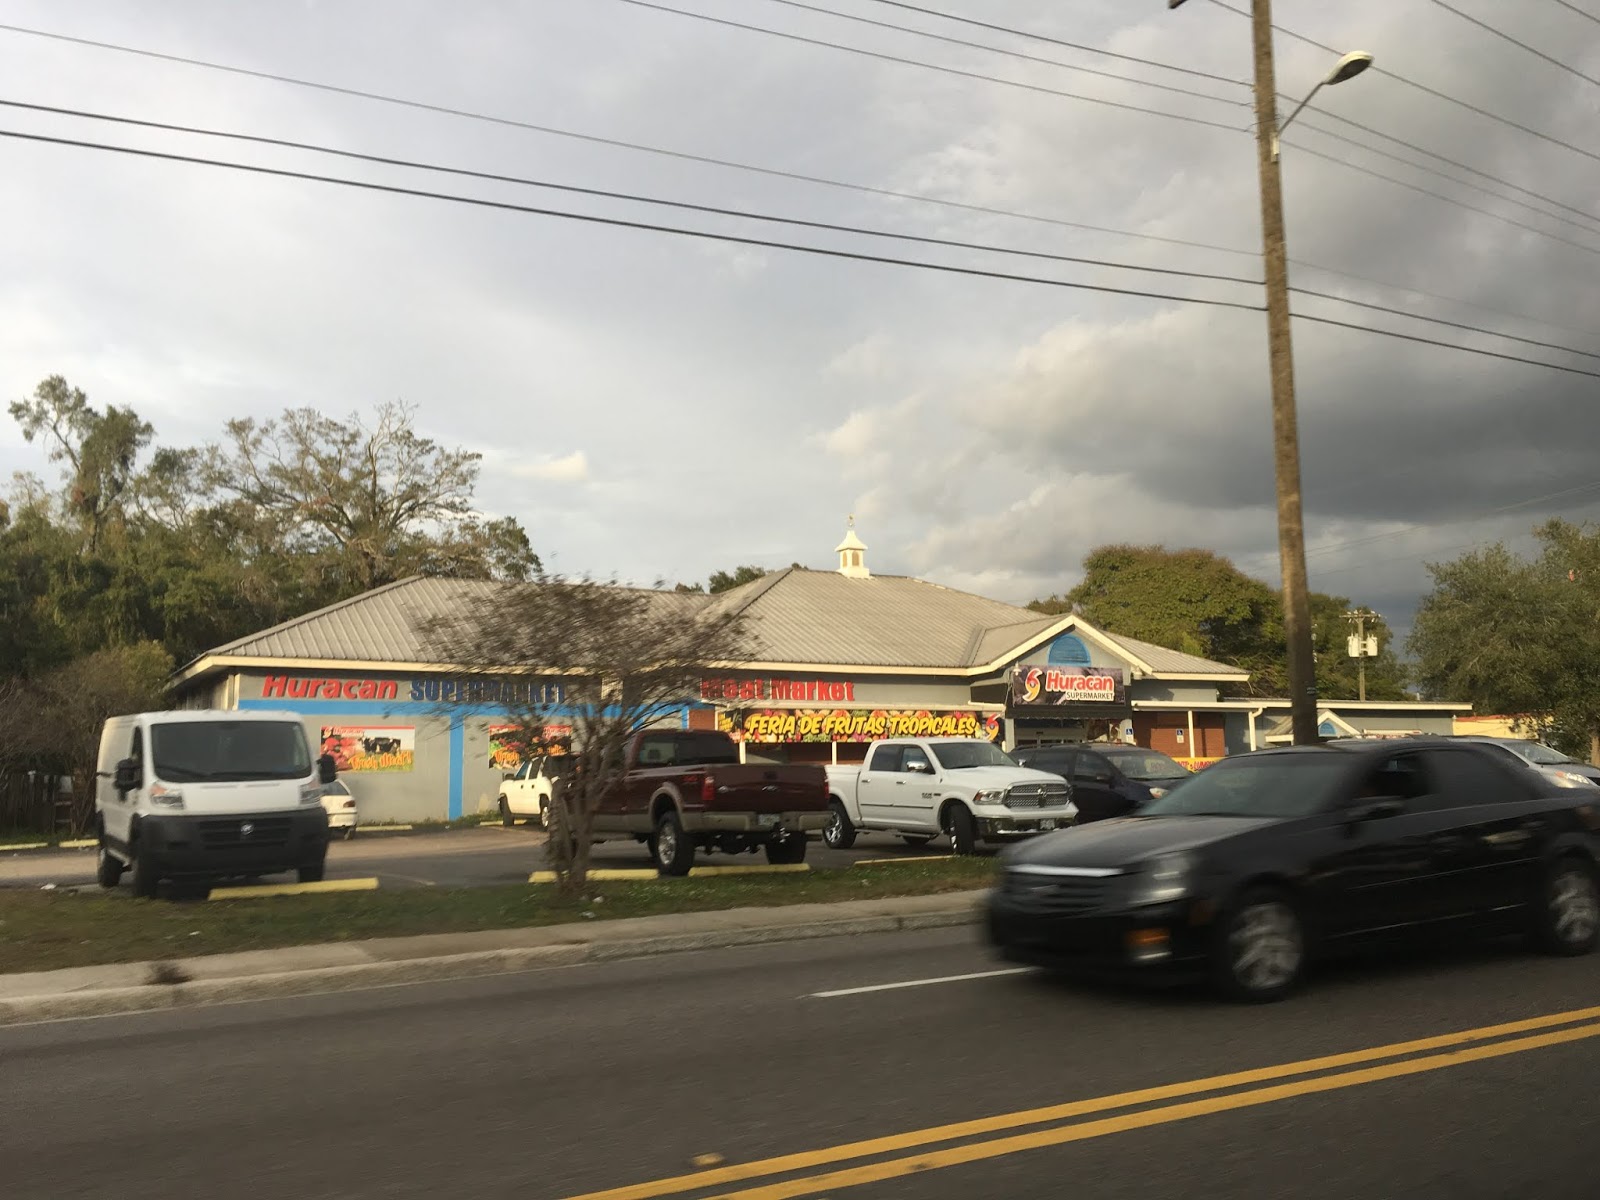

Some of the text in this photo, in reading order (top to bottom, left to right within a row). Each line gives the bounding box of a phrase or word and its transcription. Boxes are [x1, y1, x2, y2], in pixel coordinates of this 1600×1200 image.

[262, 675, 398, 700] Huracan
[770, 678, 855, 701] Market
[1046, 671, 1114, 691] Huracan
[1067, 692, 1114, 700] SUPERMARKET
[749, 716, 796, 736] FERIA
[799, 716, 822, 736] DE
[825, 716, 886, 736] FRUTAS
[890, 716, 977, 736] TROPICALES
